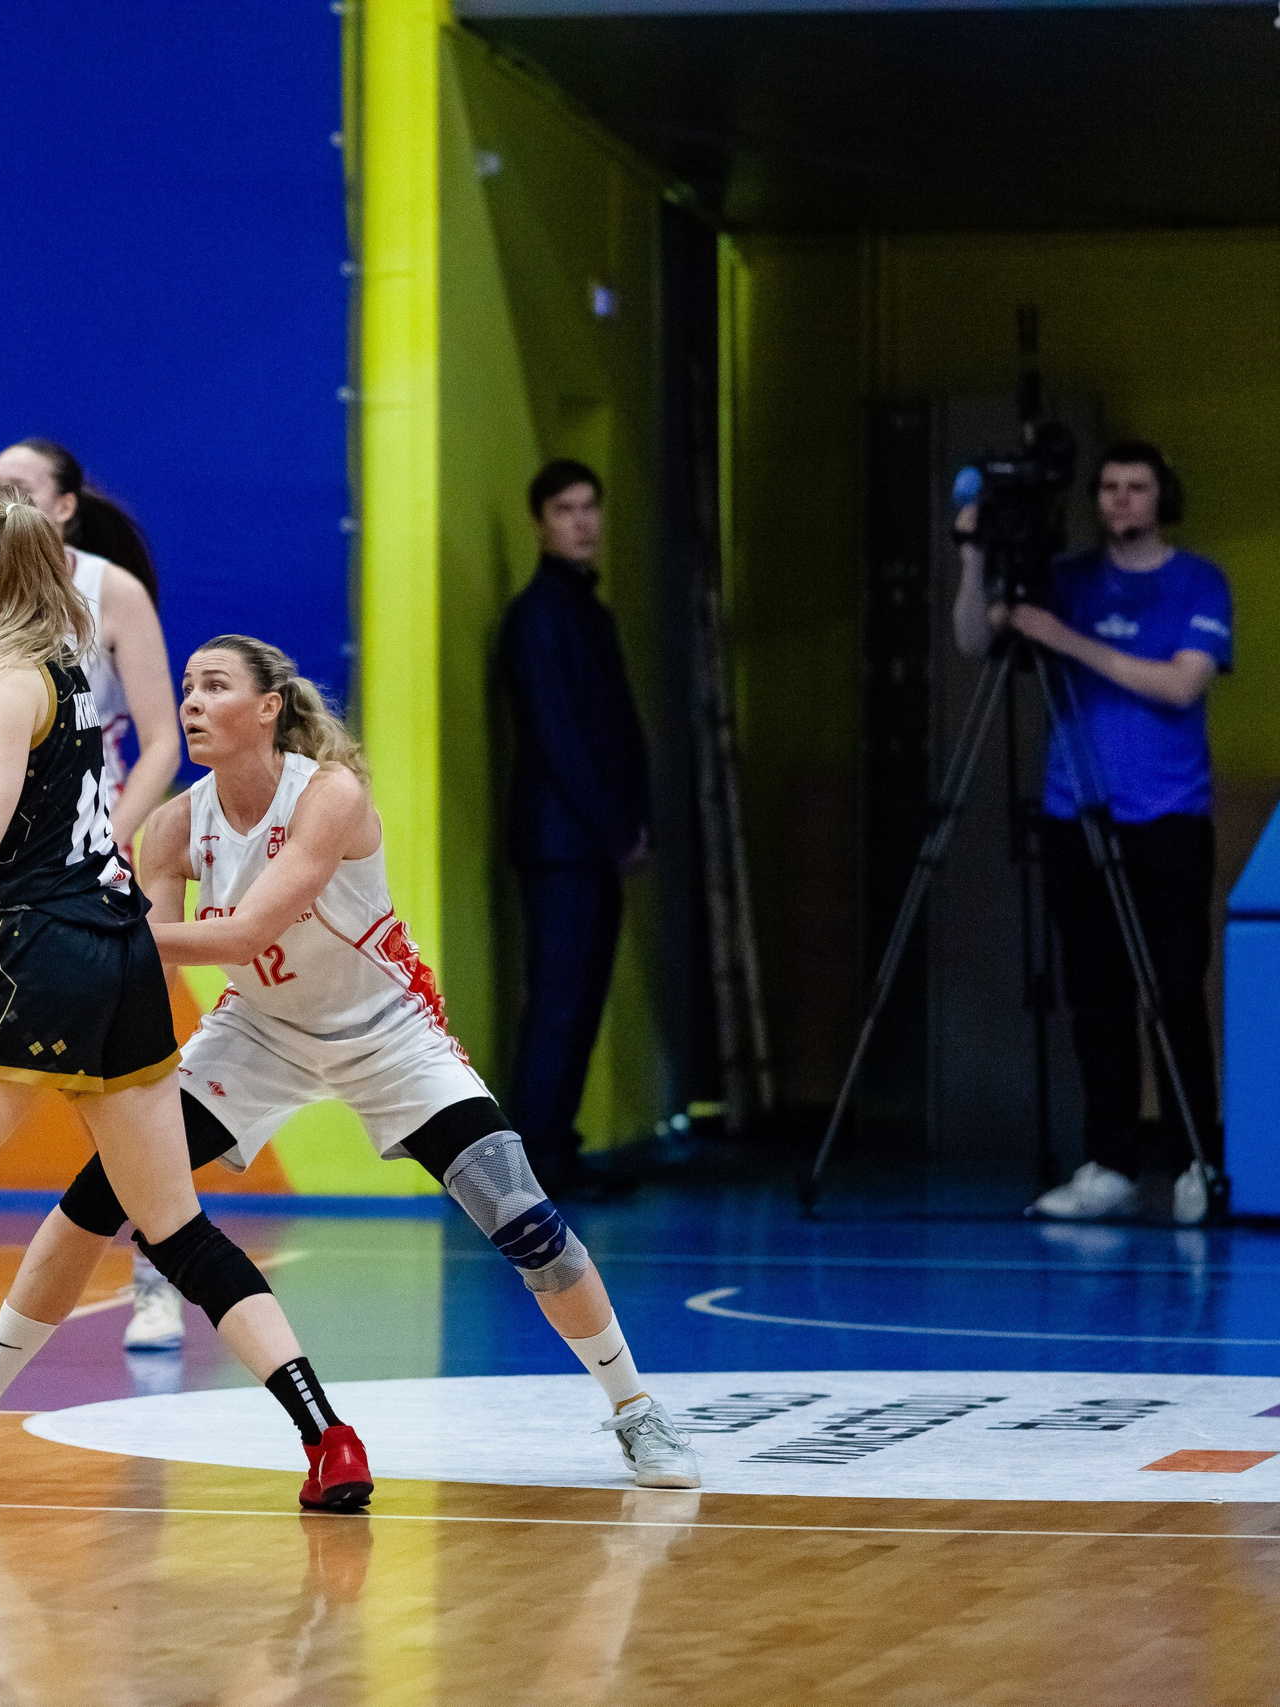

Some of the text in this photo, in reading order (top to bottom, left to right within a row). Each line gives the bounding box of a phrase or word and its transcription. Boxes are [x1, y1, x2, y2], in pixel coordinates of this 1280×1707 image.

[252, 942, 298, 988] 12
[738, 1393, 1011, 1465] ПОДДЕРЖКИ
[985, 1398, 1177, 1431] ФОНД
